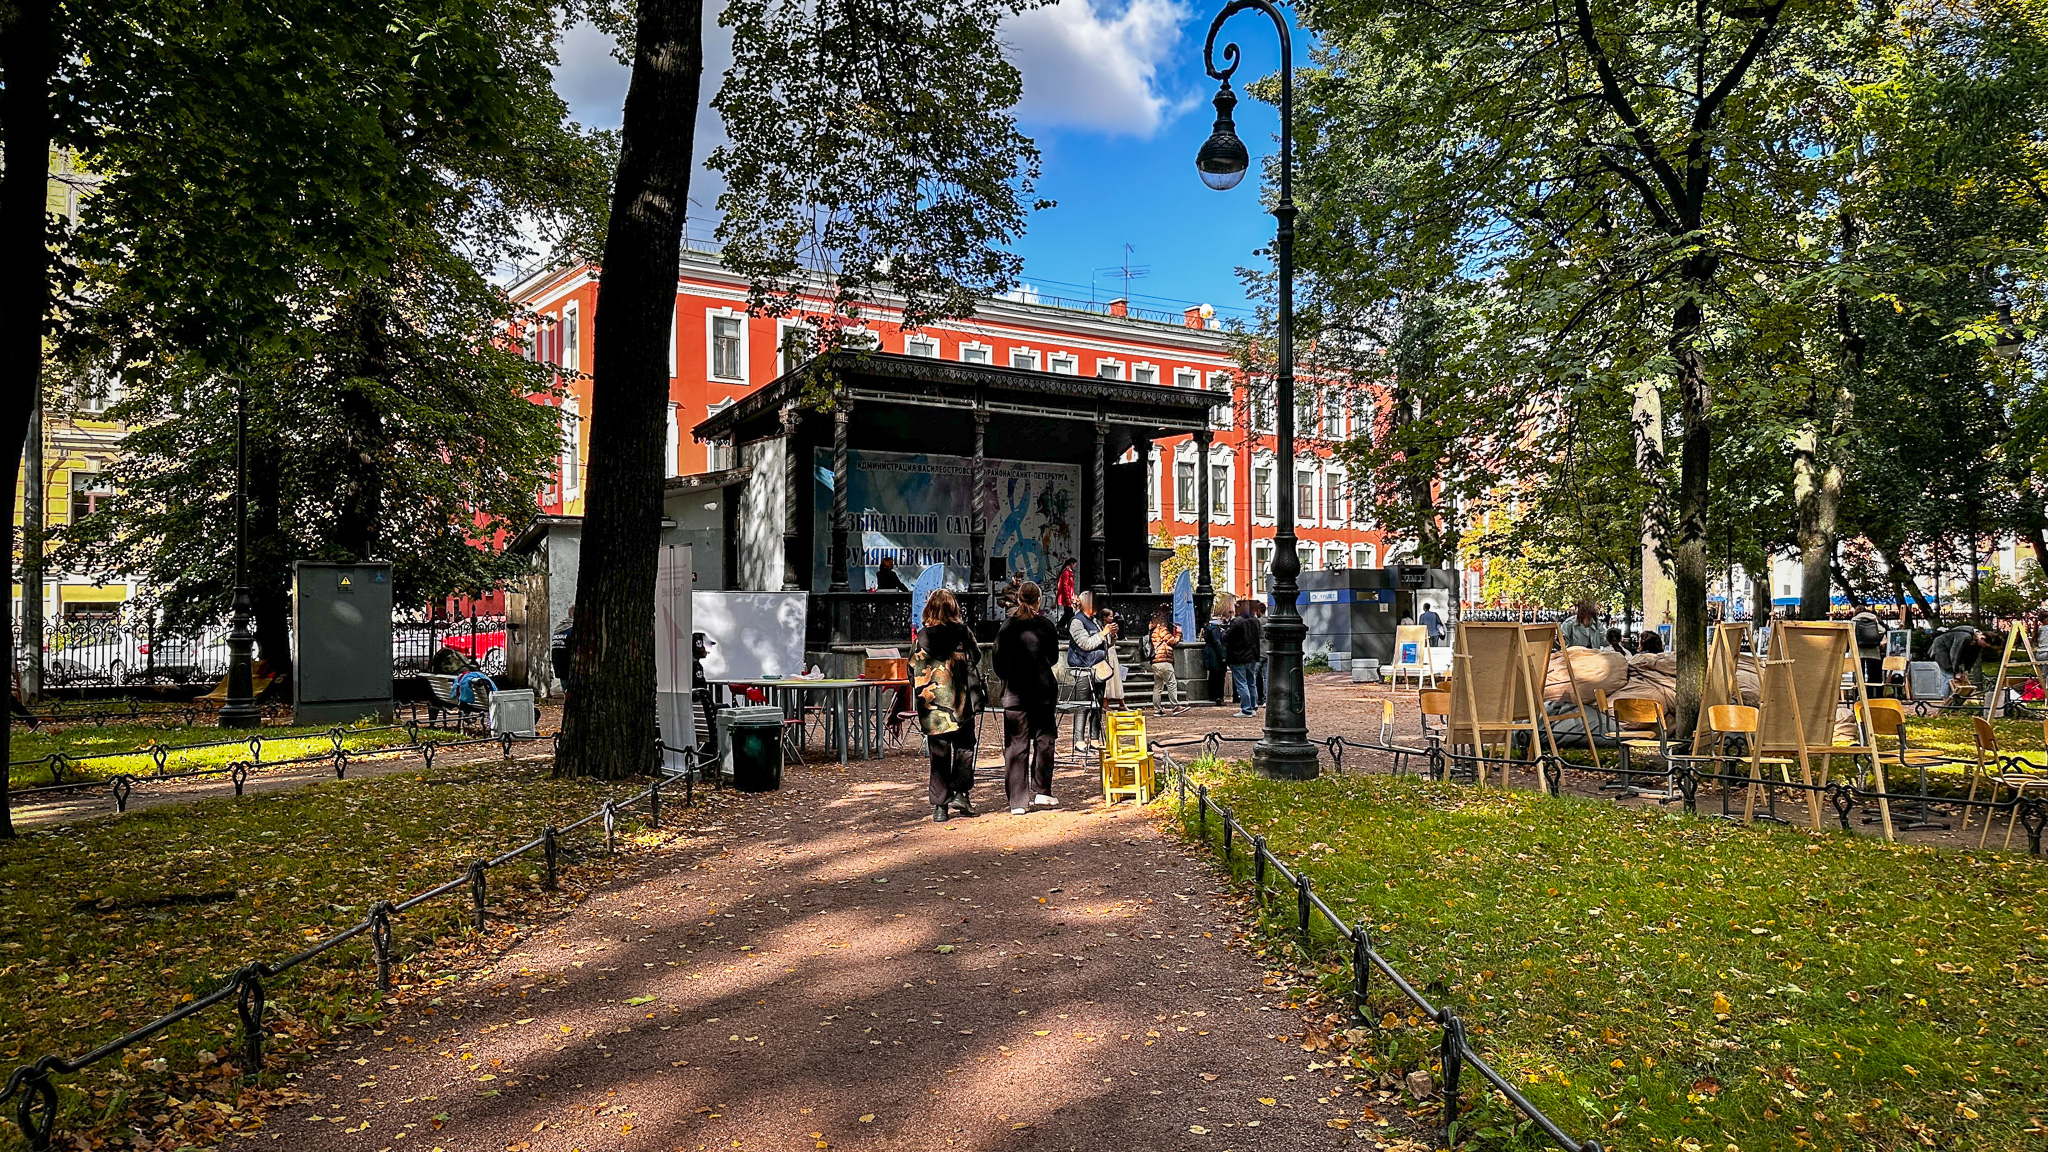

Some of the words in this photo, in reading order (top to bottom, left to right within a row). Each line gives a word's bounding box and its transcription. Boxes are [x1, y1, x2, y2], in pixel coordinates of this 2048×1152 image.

[858, 461, 916, 472] АДМИНИСТРАЦИЯ
[918, 464, 986, 476] ВАСИЛЕОСТРОВС
[987, 467, 1010, 477] РАЙОНА
[1012, 470, 1068, 481] САНКТ-ПЕТЕРБУРГА
[827, 512, 938, 534] МЗЫКАЛЬНЫЙ
